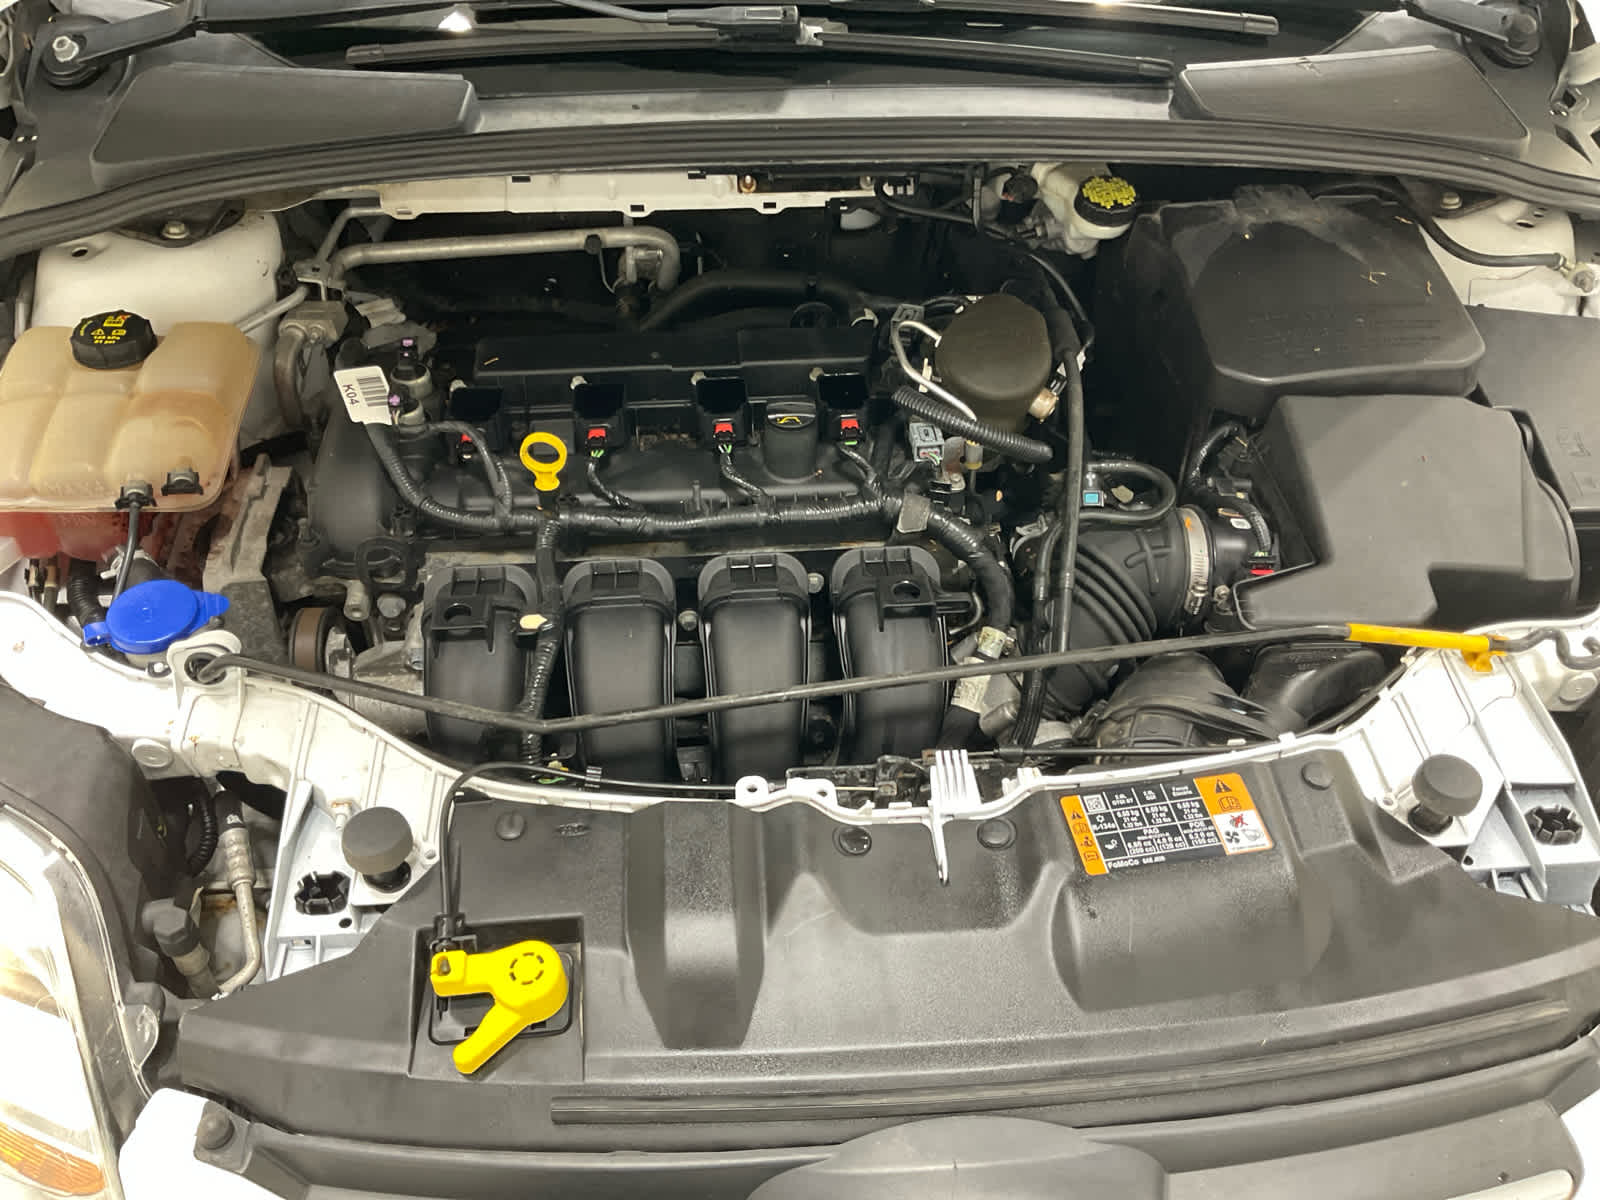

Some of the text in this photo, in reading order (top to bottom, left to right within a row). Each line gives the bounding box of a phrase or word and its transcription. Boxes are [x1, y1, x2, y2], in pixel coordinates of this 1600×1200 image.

[342, 384, 360, 405] K04
[1092, 822, 1116, 831] R-134a
[1107, 858, 1139, 868] FoMoCo
